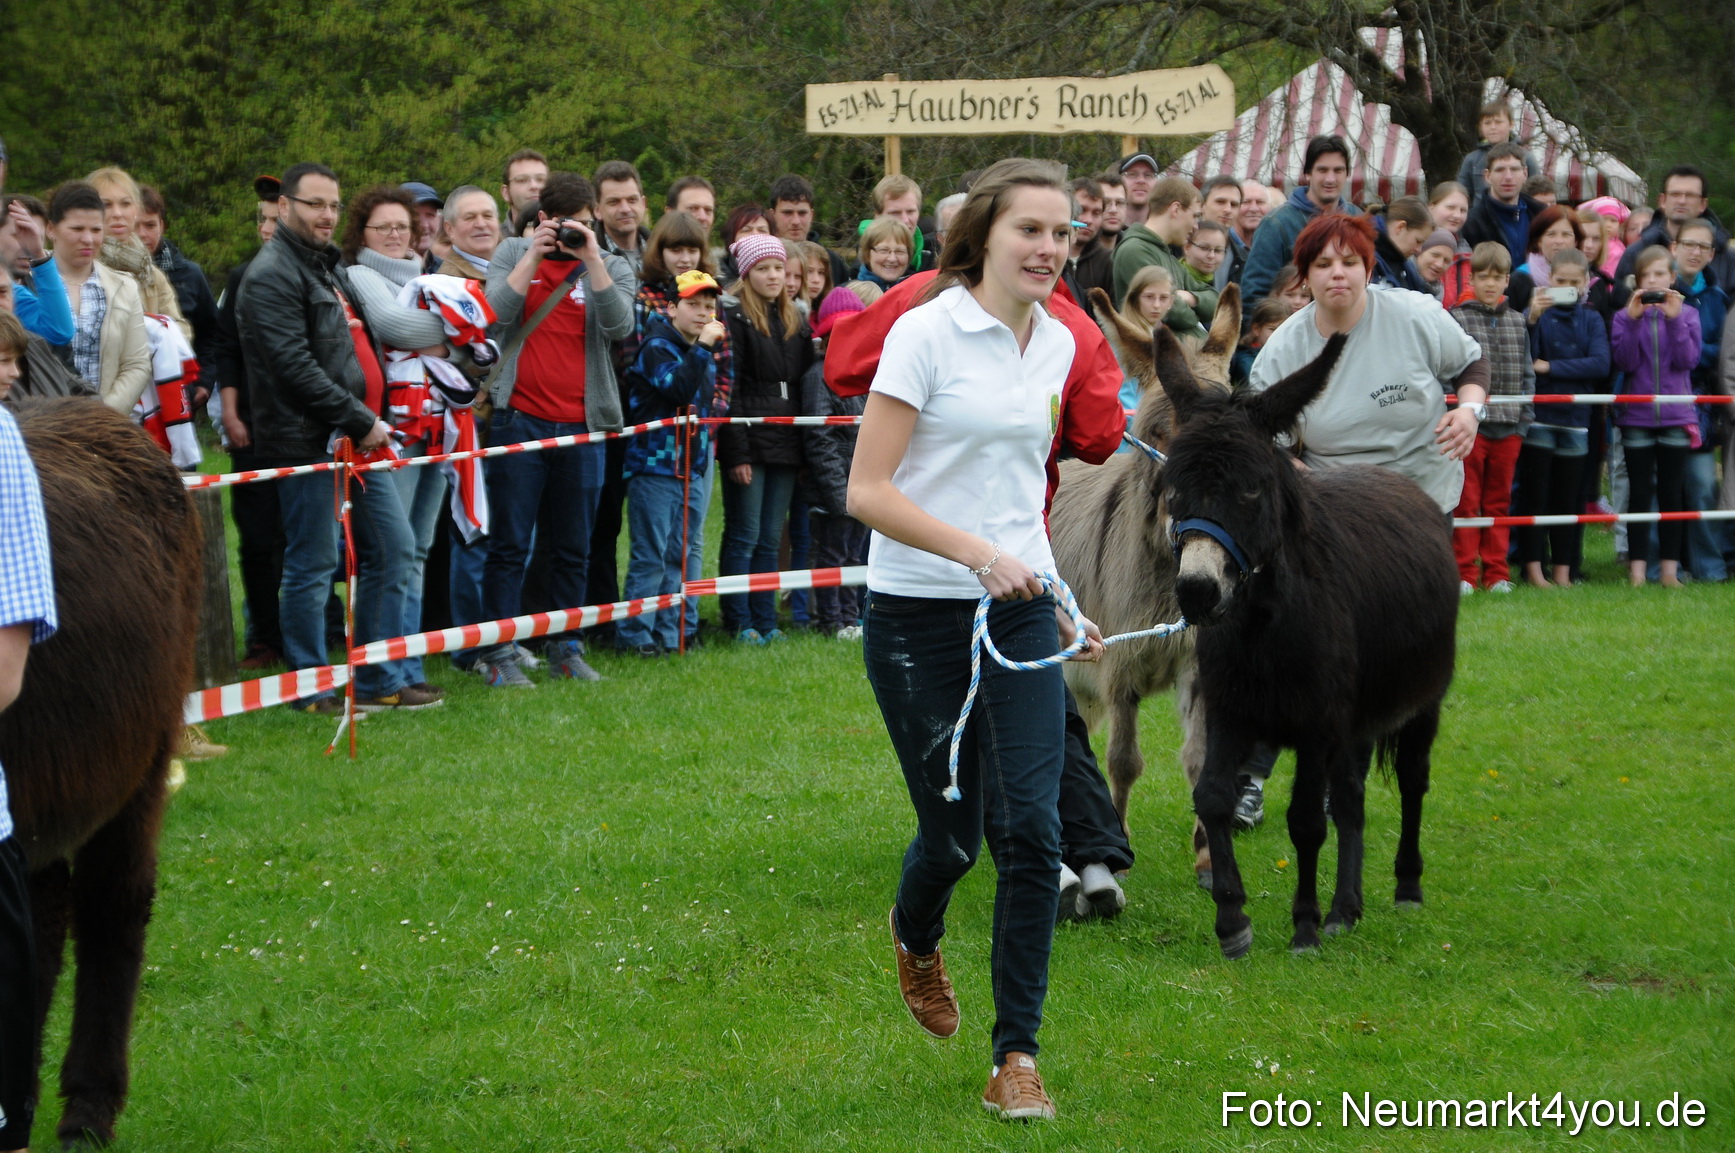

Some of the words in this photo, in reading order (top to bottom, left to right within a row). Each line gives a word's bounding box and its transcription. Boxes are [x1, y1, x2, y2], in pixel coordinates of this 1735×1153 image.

[888, 86, 1039, 123] Haubner's
[1055, 83, 1149, 125] Ranch
[1370, 384, 1409, 400] Haubner's
